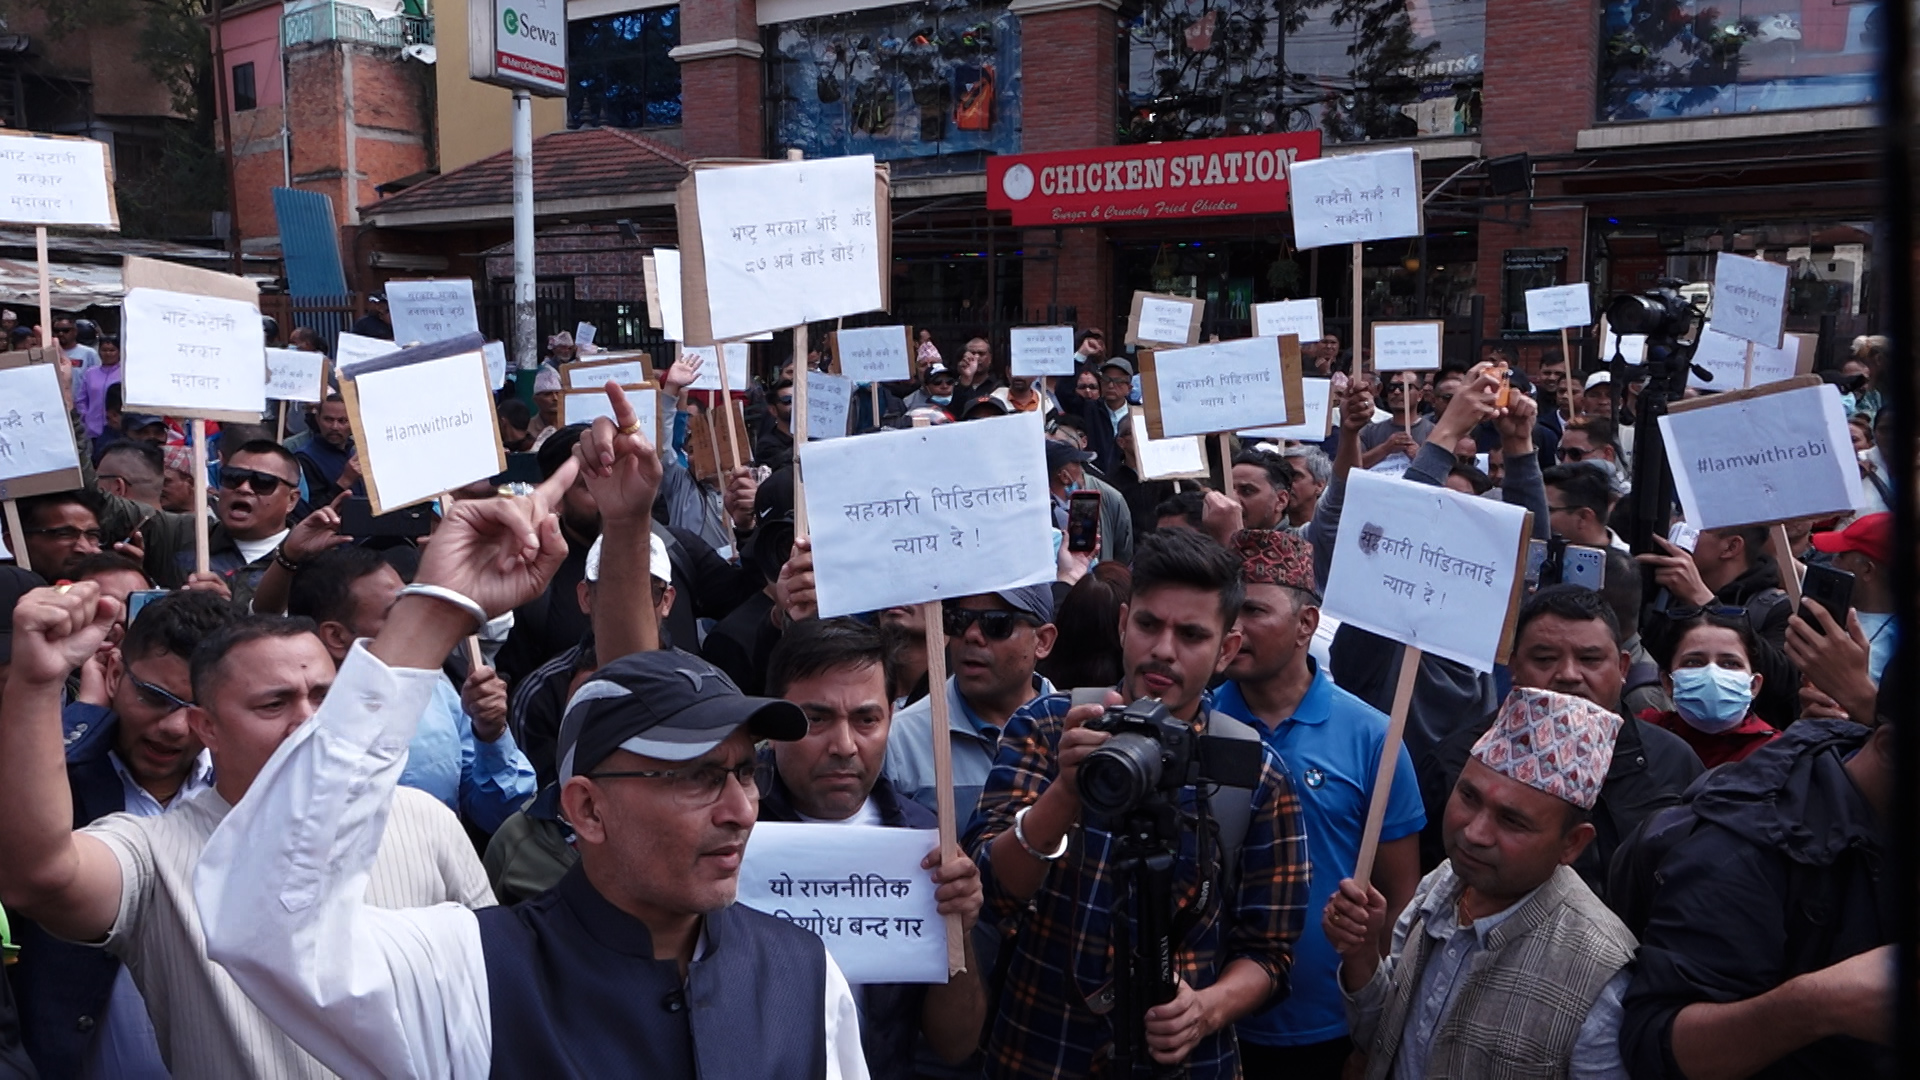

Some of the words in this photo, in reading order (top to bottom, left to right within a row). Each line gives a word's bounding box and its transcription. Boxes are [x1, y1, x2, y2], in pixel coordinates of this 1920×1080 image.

[502, 8, 557, 46] eSewa
[1040, 156, 1165, 196] CHICKEN
[1170, 147, 1298, 188] STATION
[1052, 207, 1088, 221] Burger
[1091, 206, 1101, 218] &
[1104, 203, 1149, 219] Crunchy
[1154, 201, 1188, 216] Fried
[1191, 199, 1238, 214] Chicken
[765, 219, 808, 238] सरकार
[385, 407, 474, 442] #Iamwithrabi
[1697, 439, 1828, 474] #Iamwithrabi
[843, 490, 921, 522] सहकारी
[931, 476, 1028, 512] पिडितलाई
[892, 533, 940, 554] न्याय
[949, 526, 965, 548] दे
[1361, 530, 1415, 560] सहकारी
[1418, 542, 1497, 588] पिडितलाई
[1382, 573, 1418, 600] न्याय
[1423, 581, 1435, 606] दे
[768, 871, 794, 898] यो
[797, 872, 912, 898] राजनीतिक
[847, 917, 890, 939] बन्द
[894, 918, 924, 938] गर
